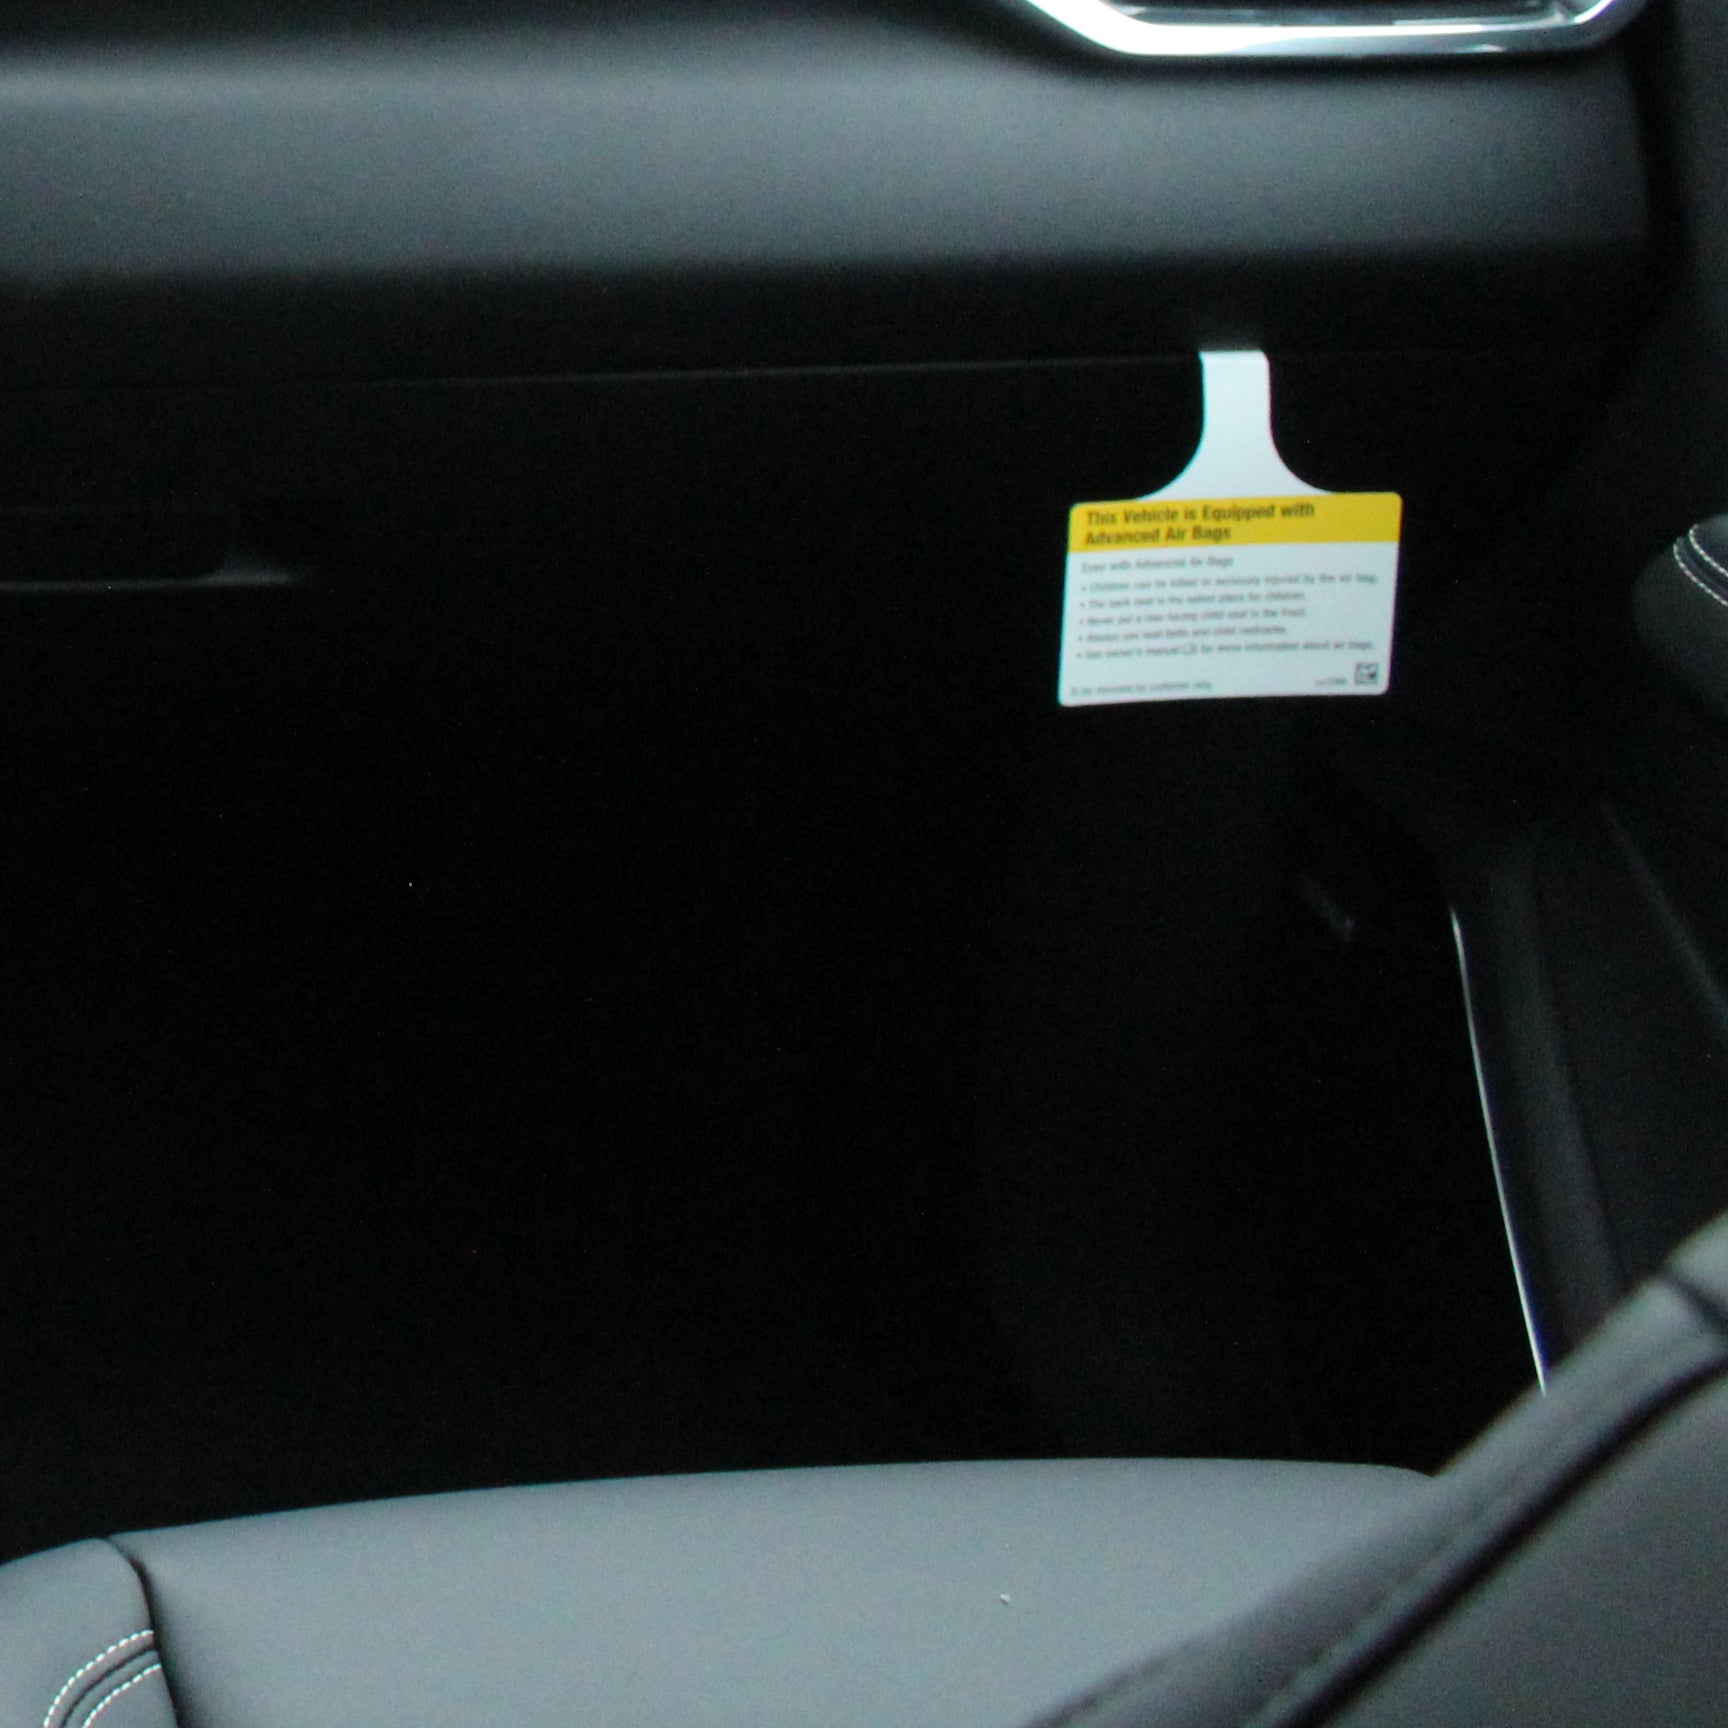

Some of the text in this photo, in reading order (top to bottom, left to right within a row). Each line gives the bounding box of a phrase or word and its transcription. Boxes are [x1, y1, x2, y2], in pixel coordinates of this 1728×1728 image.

[1087, 503, 1315, 525] This Vehicle is Equipped with
[1086, 525, 1231, 545] Advanced Air Bags
